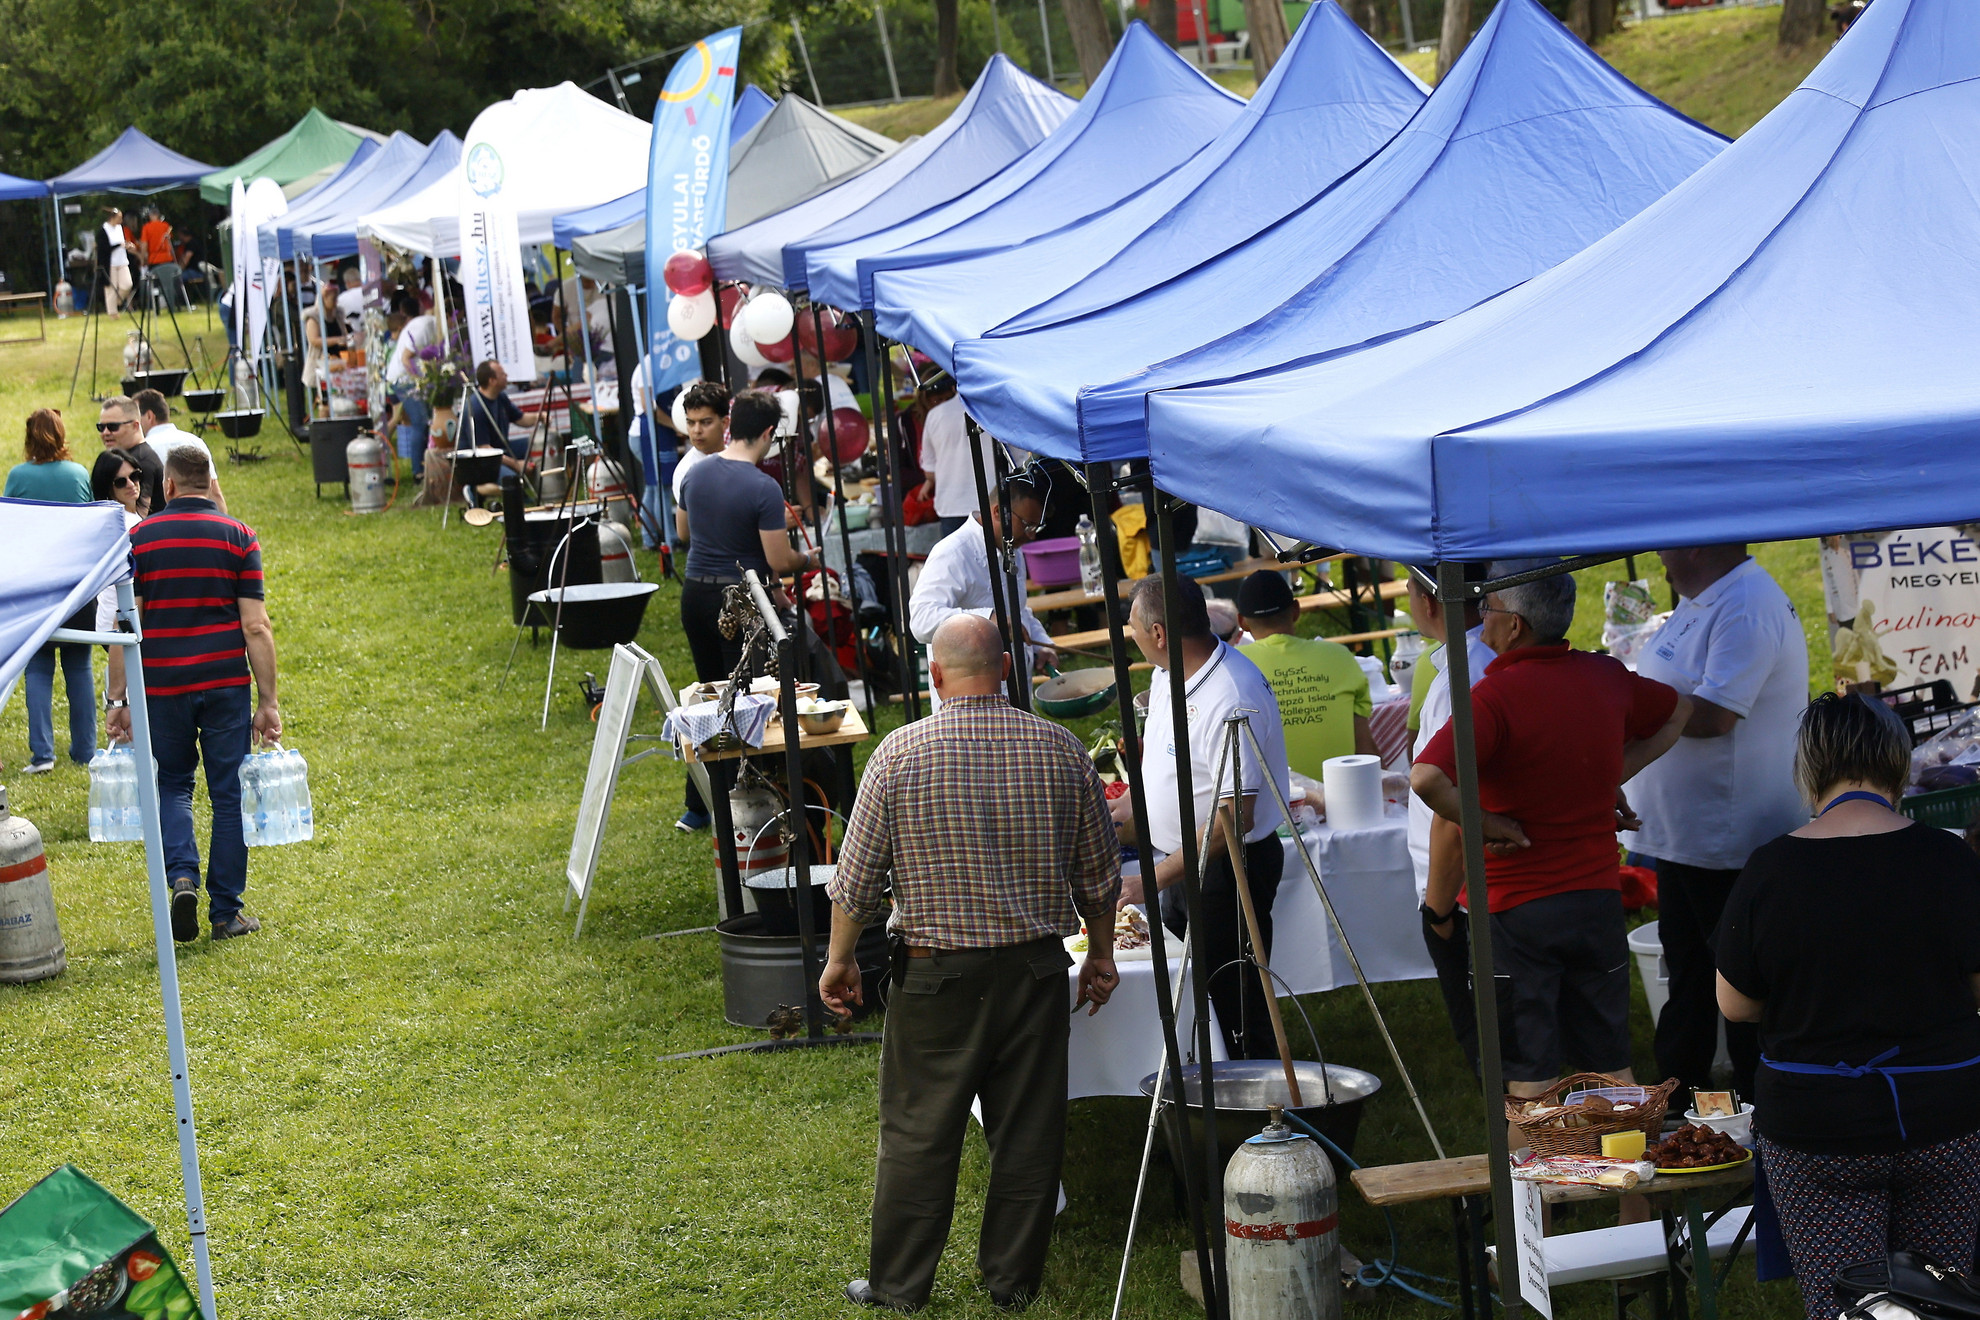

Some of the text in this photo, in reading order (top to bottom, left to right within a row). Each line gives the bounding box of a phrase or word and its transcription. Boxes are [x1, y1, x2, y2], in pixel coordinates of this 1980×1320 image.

[673, 173, 689, 253] GYULAI
[1850, 532, 1980, 569] BÉKÉ
[1891, 571, 1980, 588] MEGYEI
[1873, 605, 1980, 633] culinar
[1903, 645, 1969, 675] TEAM
[1274, 666, 1307, 678] GySzC
[1282, 714, 1324, 726] ARVAS
[0, 914, 32, 925] AGAZ
